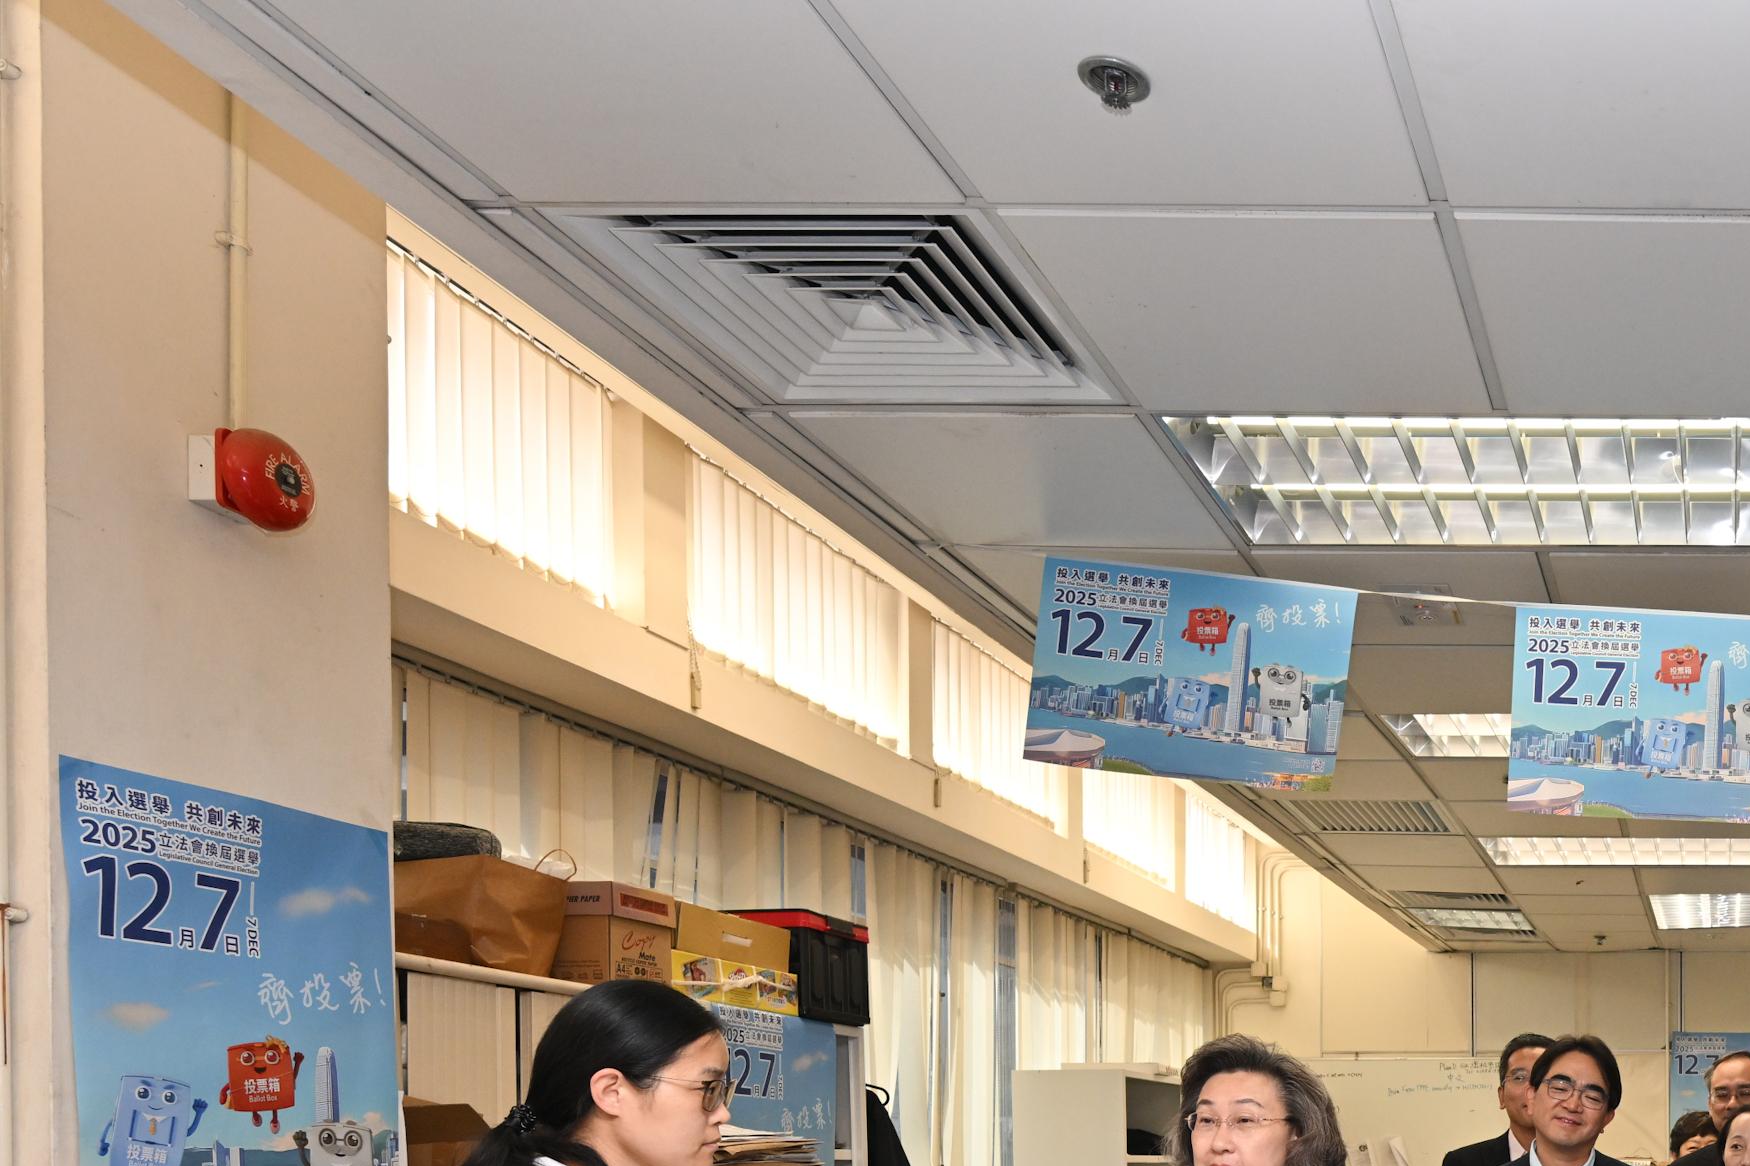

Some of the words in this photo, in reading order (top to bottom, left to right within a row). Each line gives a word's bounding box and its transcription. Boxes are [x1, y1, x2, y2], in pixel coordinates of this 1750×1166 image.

[265, 454, 279, 480] FIRE
[281, 452, 312, 495] ALARM
[1057, 567, 1109, 583] 投入選舉
[1119, 574, 1169, 590] 共創未來
[1529, 617, 1580, 630] 投入選舉
[1590, 620, 1640, 632] 共創未來
[78, 780, 170, 815] 投入選舉
[186, 802, 260, 835] 共創未來
[78, 803, 98, 812] Join
[100, 806, 114, 815] the
[117, 808, 150, 823] Election
[153, 815, 187, 830] Together
[189, 824, 201, 832] We
[202, 826, 224, 837] Create
[227, 831, 238, 840] the
[240, 834, 261, 845] Future
[159, 851, 190, 864] Legislative
[192, 857, 213, 866] Council
[215, 861, 236, 870] General
[237, 865, 258, 875] Election
[622, 931, 656, 950] Copy
[639, 952, 655, 961] Mate
[244, 1077, 280, 1094] 投票箱
[249, 1094, 266, 1102] Ballot
[268, 1094, 278, 1102] Box
[127, 1144, 166, 1164] 投票箱
